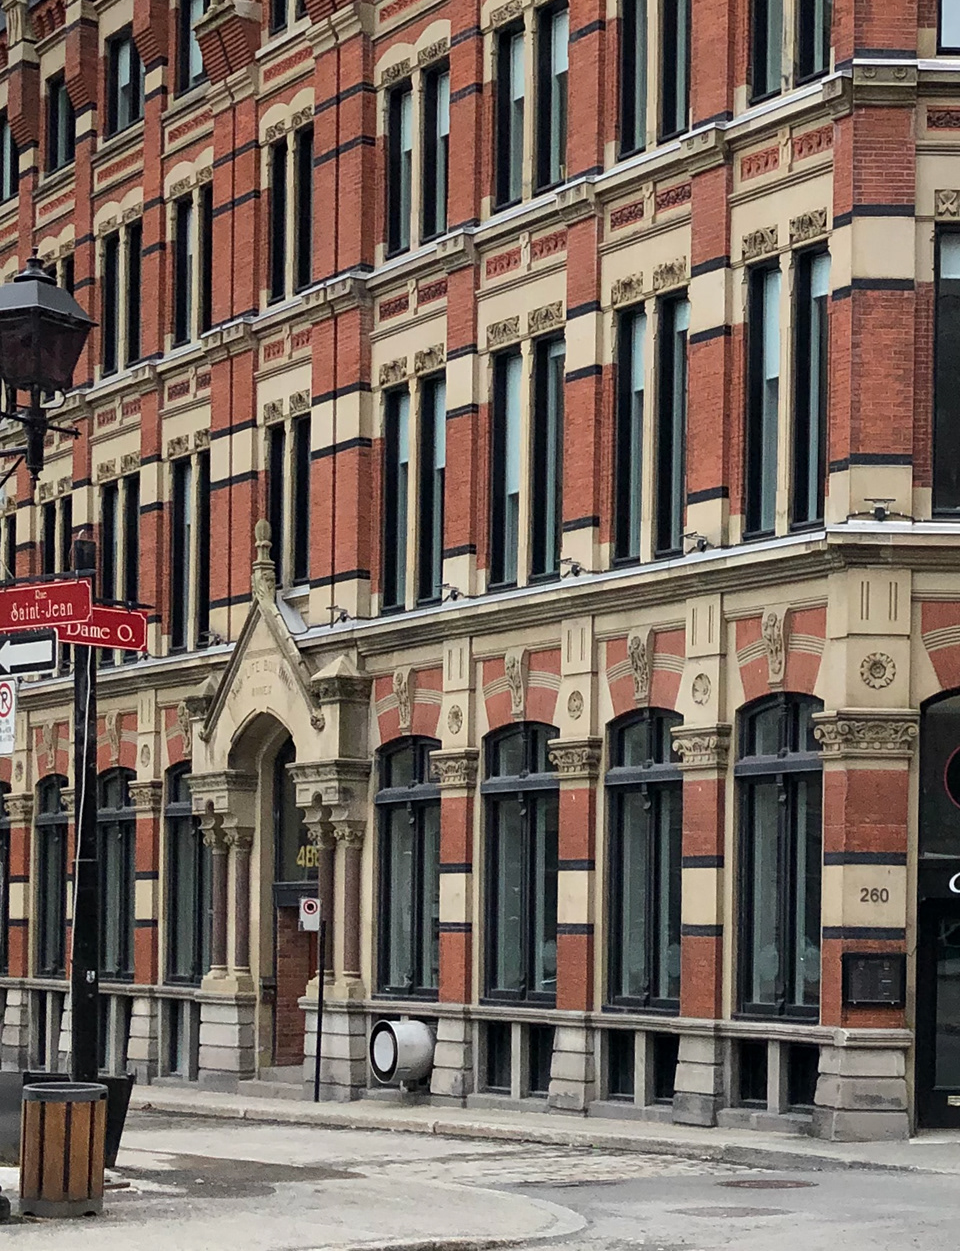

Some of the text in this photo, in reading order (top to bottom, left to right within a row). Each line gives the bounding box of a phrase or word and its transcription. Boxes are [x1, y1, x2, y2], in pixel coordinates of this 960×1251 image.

[35, 589, 47, 599] Rue
[10, 599, 73, 622] Saint-Jean
[117, 624, 136, 642] O.
[860, 888, 889, 902] 260
